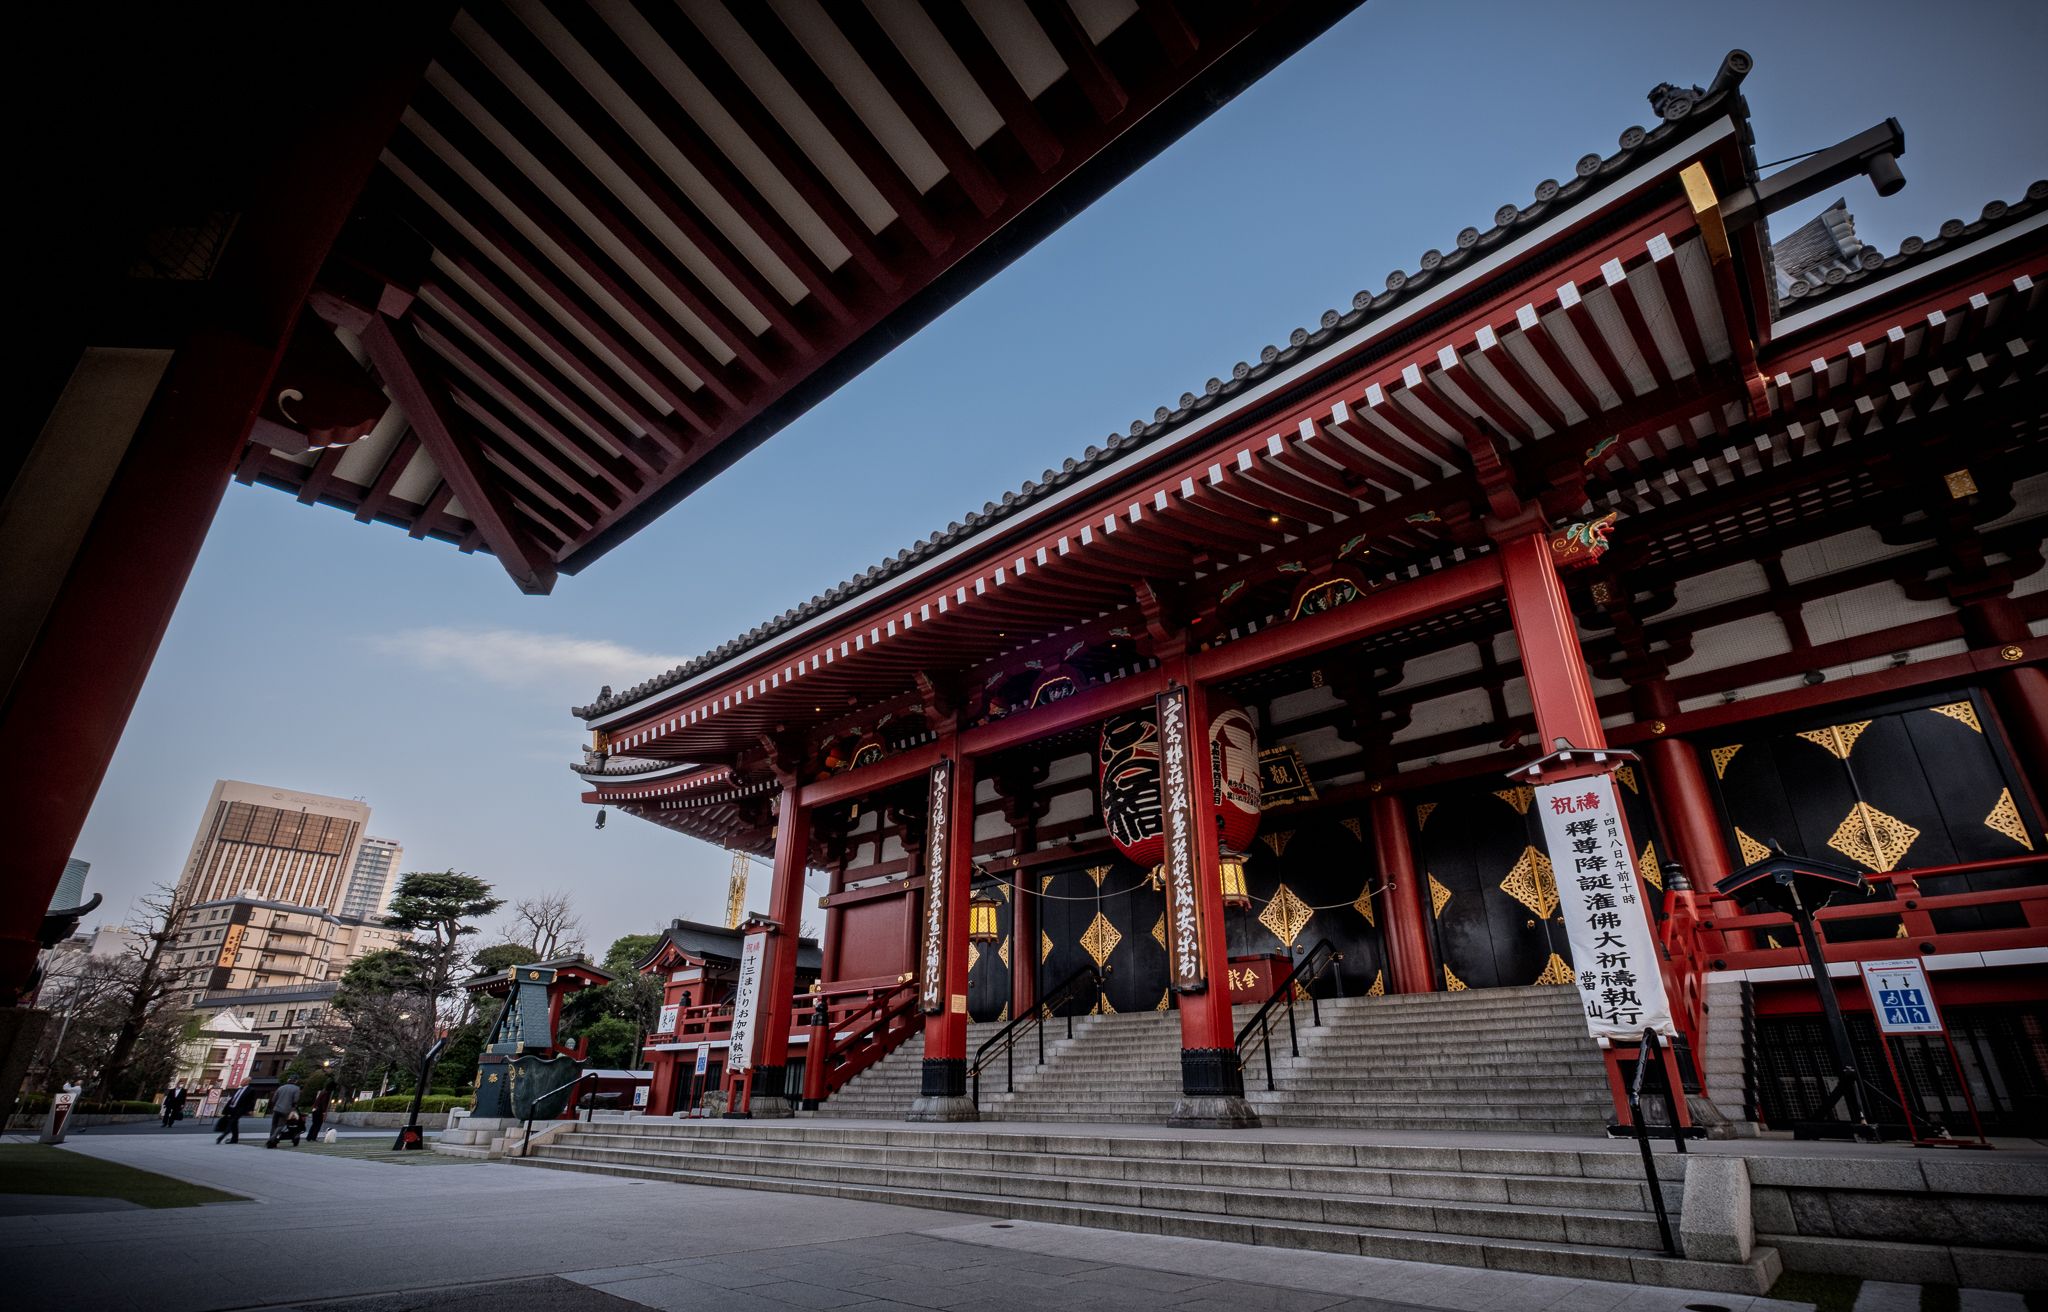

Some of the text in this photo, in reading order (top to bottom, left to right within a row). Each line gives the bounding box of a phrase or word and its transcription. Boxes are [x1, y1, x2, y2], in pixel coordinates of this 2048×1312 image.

[1603, 817, 1636, 905] 四月八日午前十時
[732, 956, 757, 1064] 十三まいりお加持執行
